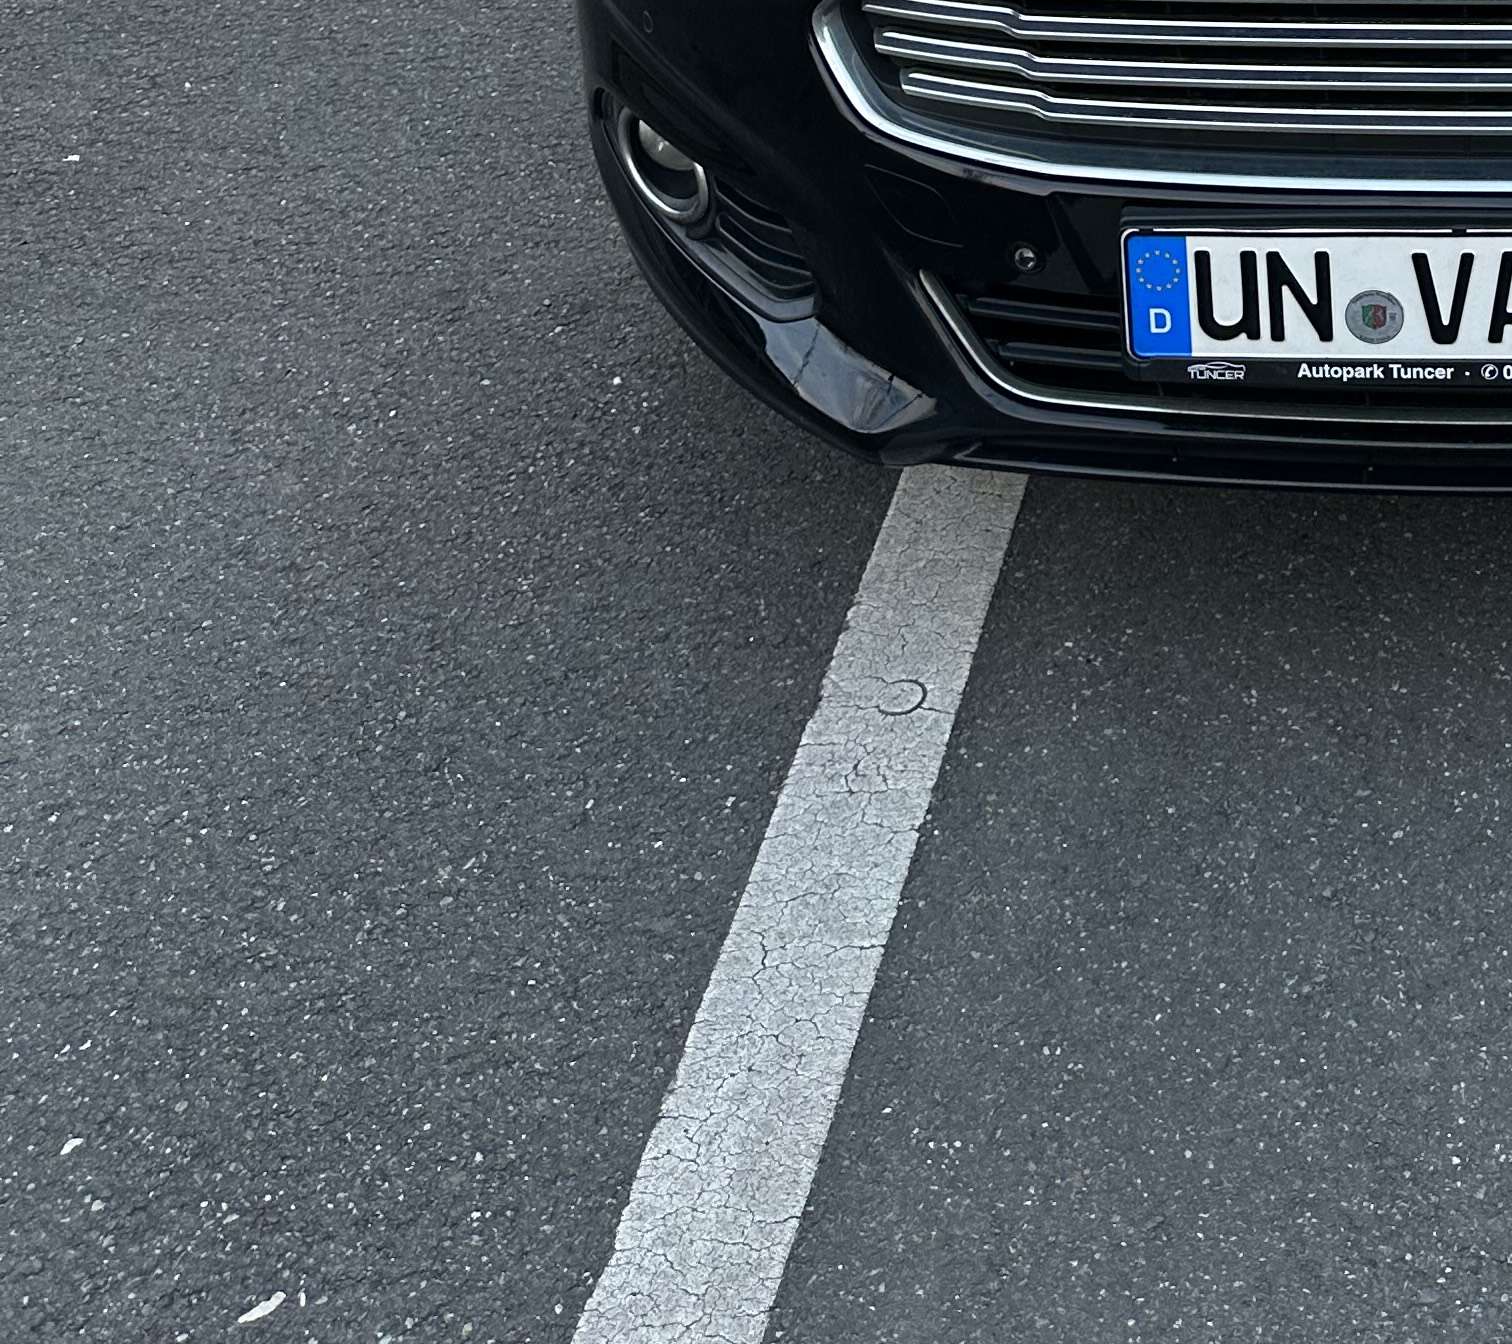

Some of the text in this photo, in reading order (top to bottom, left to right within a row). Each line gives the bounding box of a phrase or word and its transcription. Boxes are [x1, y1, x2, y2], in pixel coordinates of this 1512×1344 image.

[1194, 250, 1334, 342] UN
[1149, 307, 1172, 334] D
[1188, 368, 1245, 380] TUNCER
[1298, 362, 1385, 382] Autopark
[1389, 363, 1454, 380] Tuncer
